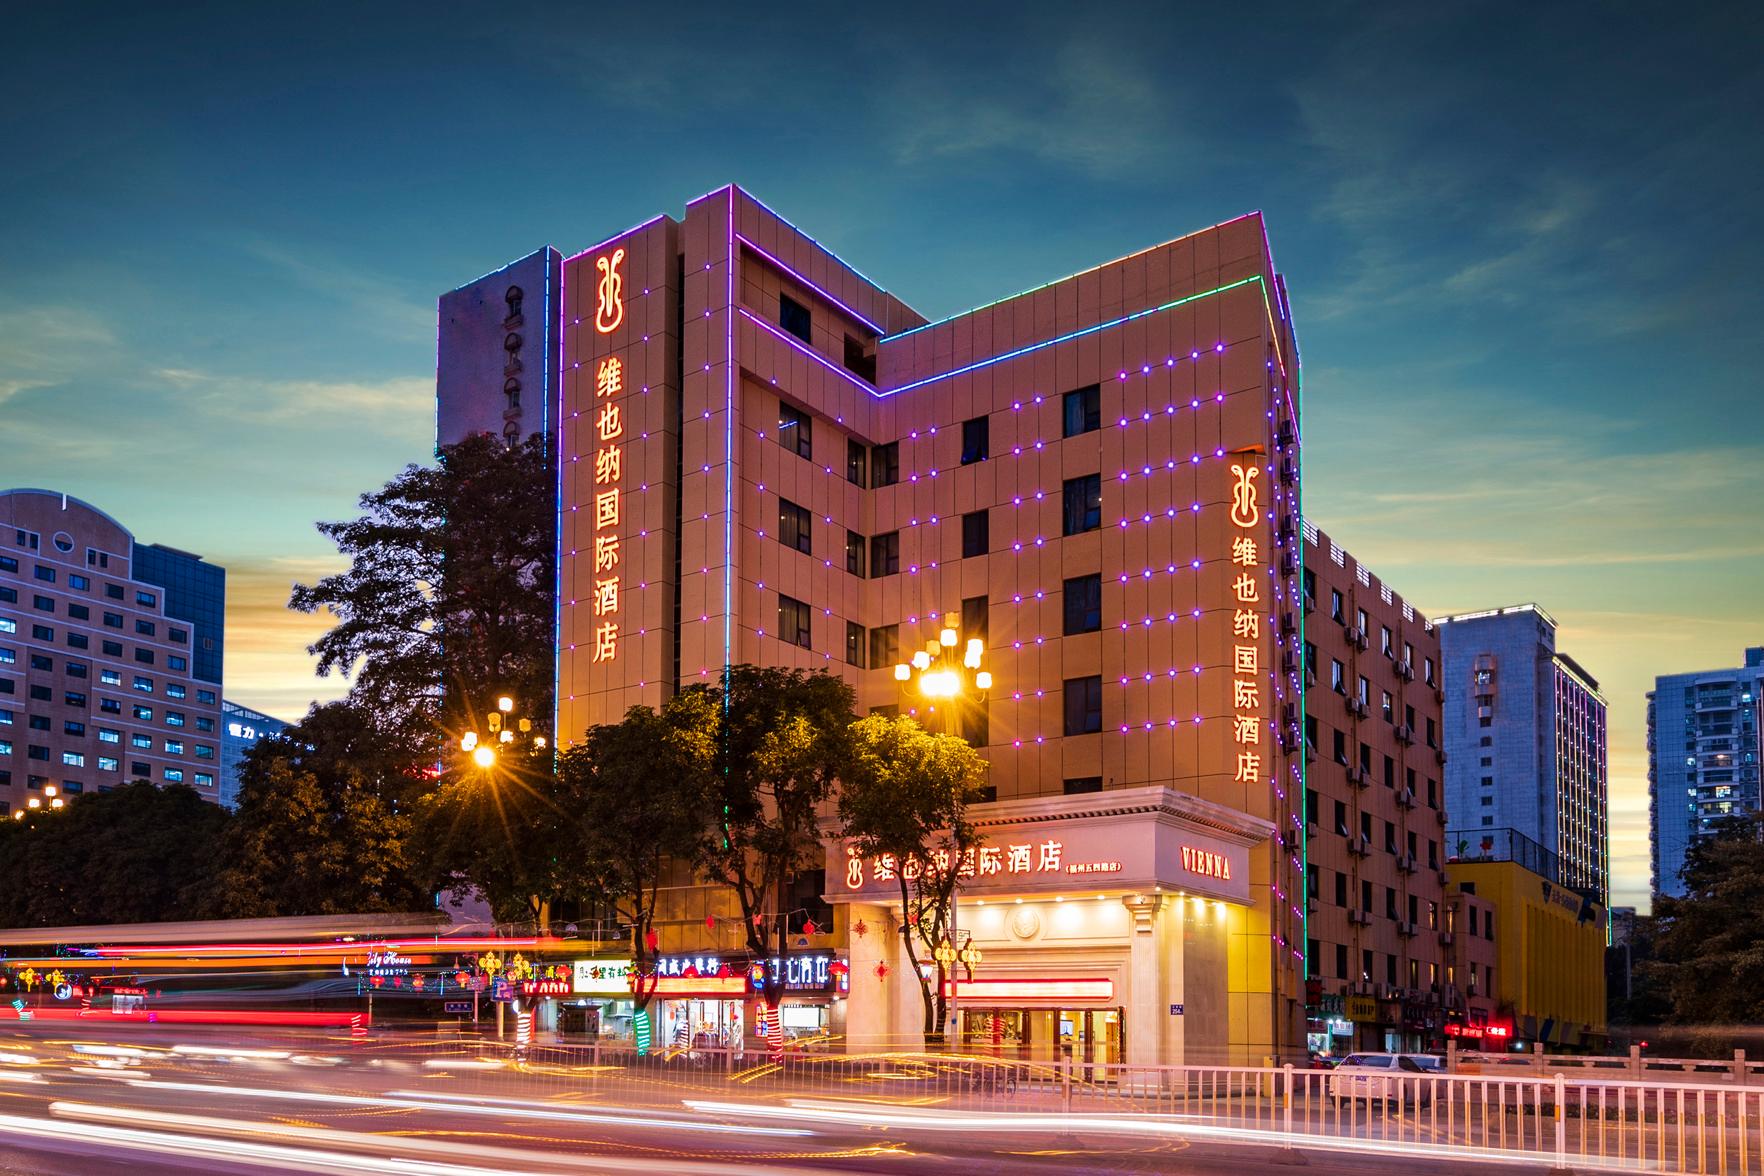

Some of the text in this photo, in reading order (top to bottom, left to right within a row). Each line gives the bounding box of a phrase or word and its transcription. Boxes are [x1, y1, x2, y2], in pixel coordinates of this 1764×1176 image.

[593, 357, 623, 663] 维也纳国际酒店
[1231, 537, 1261, 783] 维也纳国际酒店
[1181, 846, 1230, 880] VIENNA
